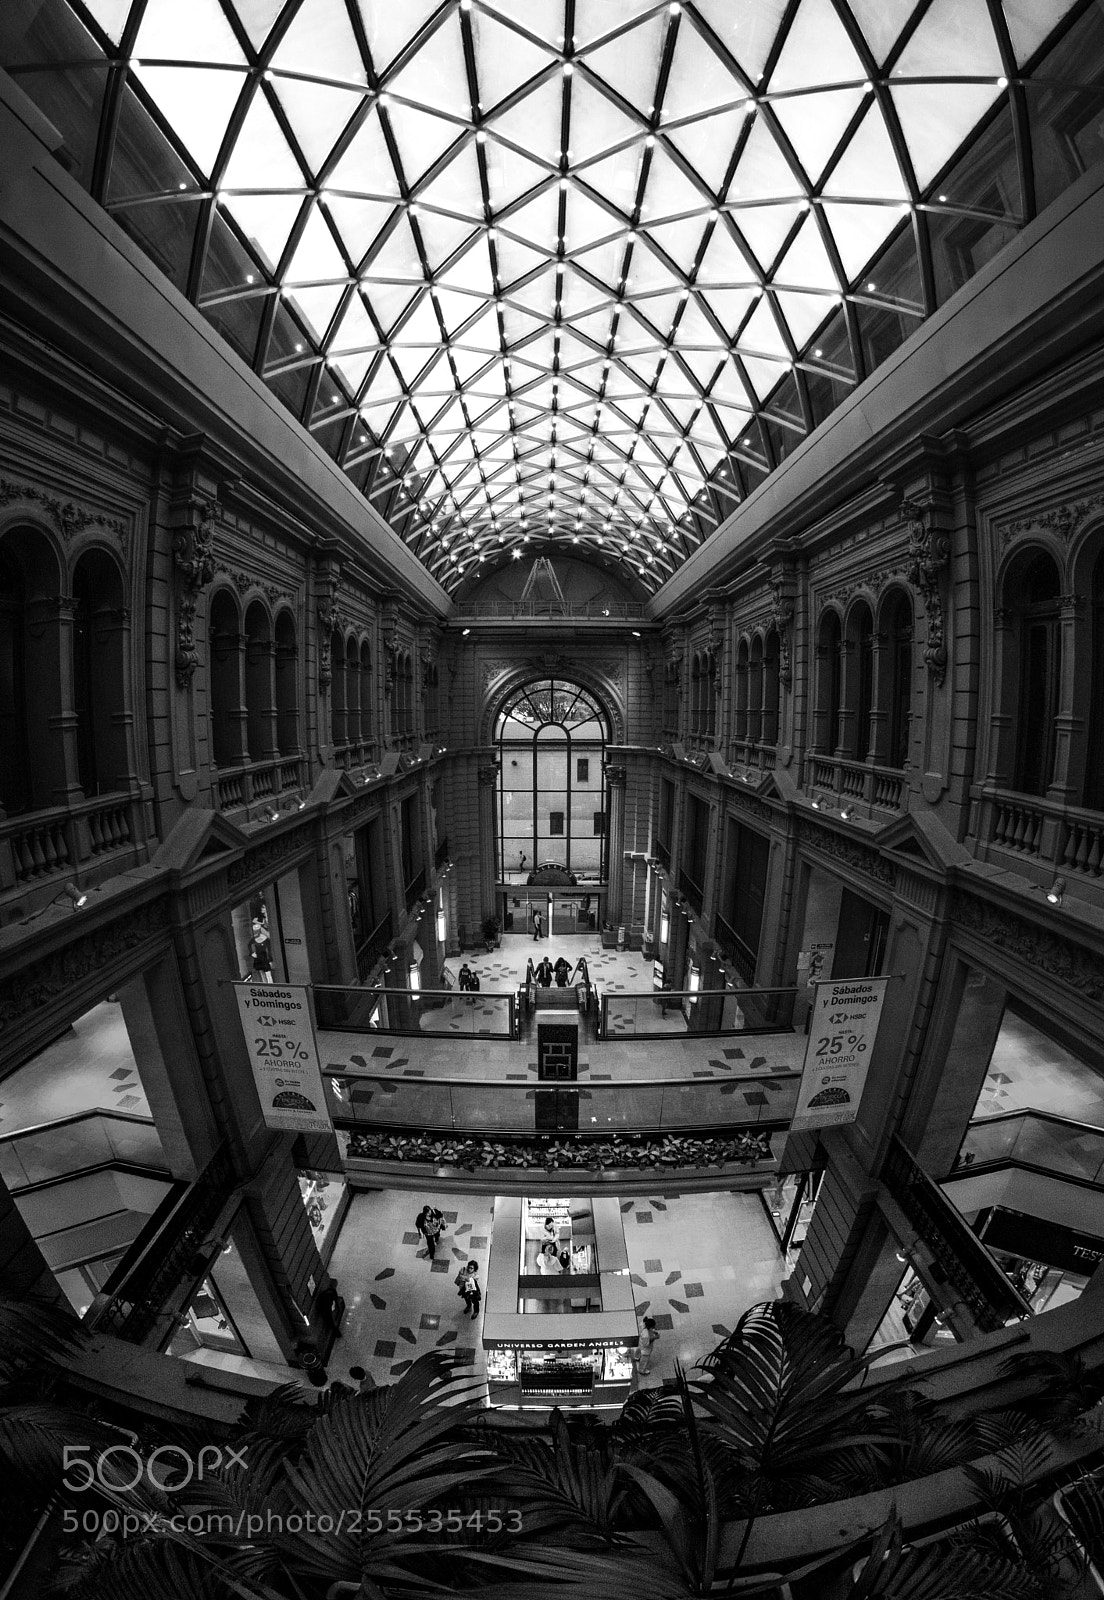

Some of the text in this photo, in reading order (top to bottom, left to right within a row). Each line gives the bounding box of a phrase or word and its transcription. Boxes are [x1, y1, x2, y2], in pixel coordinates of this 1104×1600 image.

[250, 988, 292, 999] Sábados
[832, 985, 873, 996] Sábados
[244, 999, 302, 1011] y Domingos
[822, 994, 878, 1008] y Domingos
[264, 1059, 301, 1069] AHORRO
[818, 1055, 856, 1066] AHORRO
